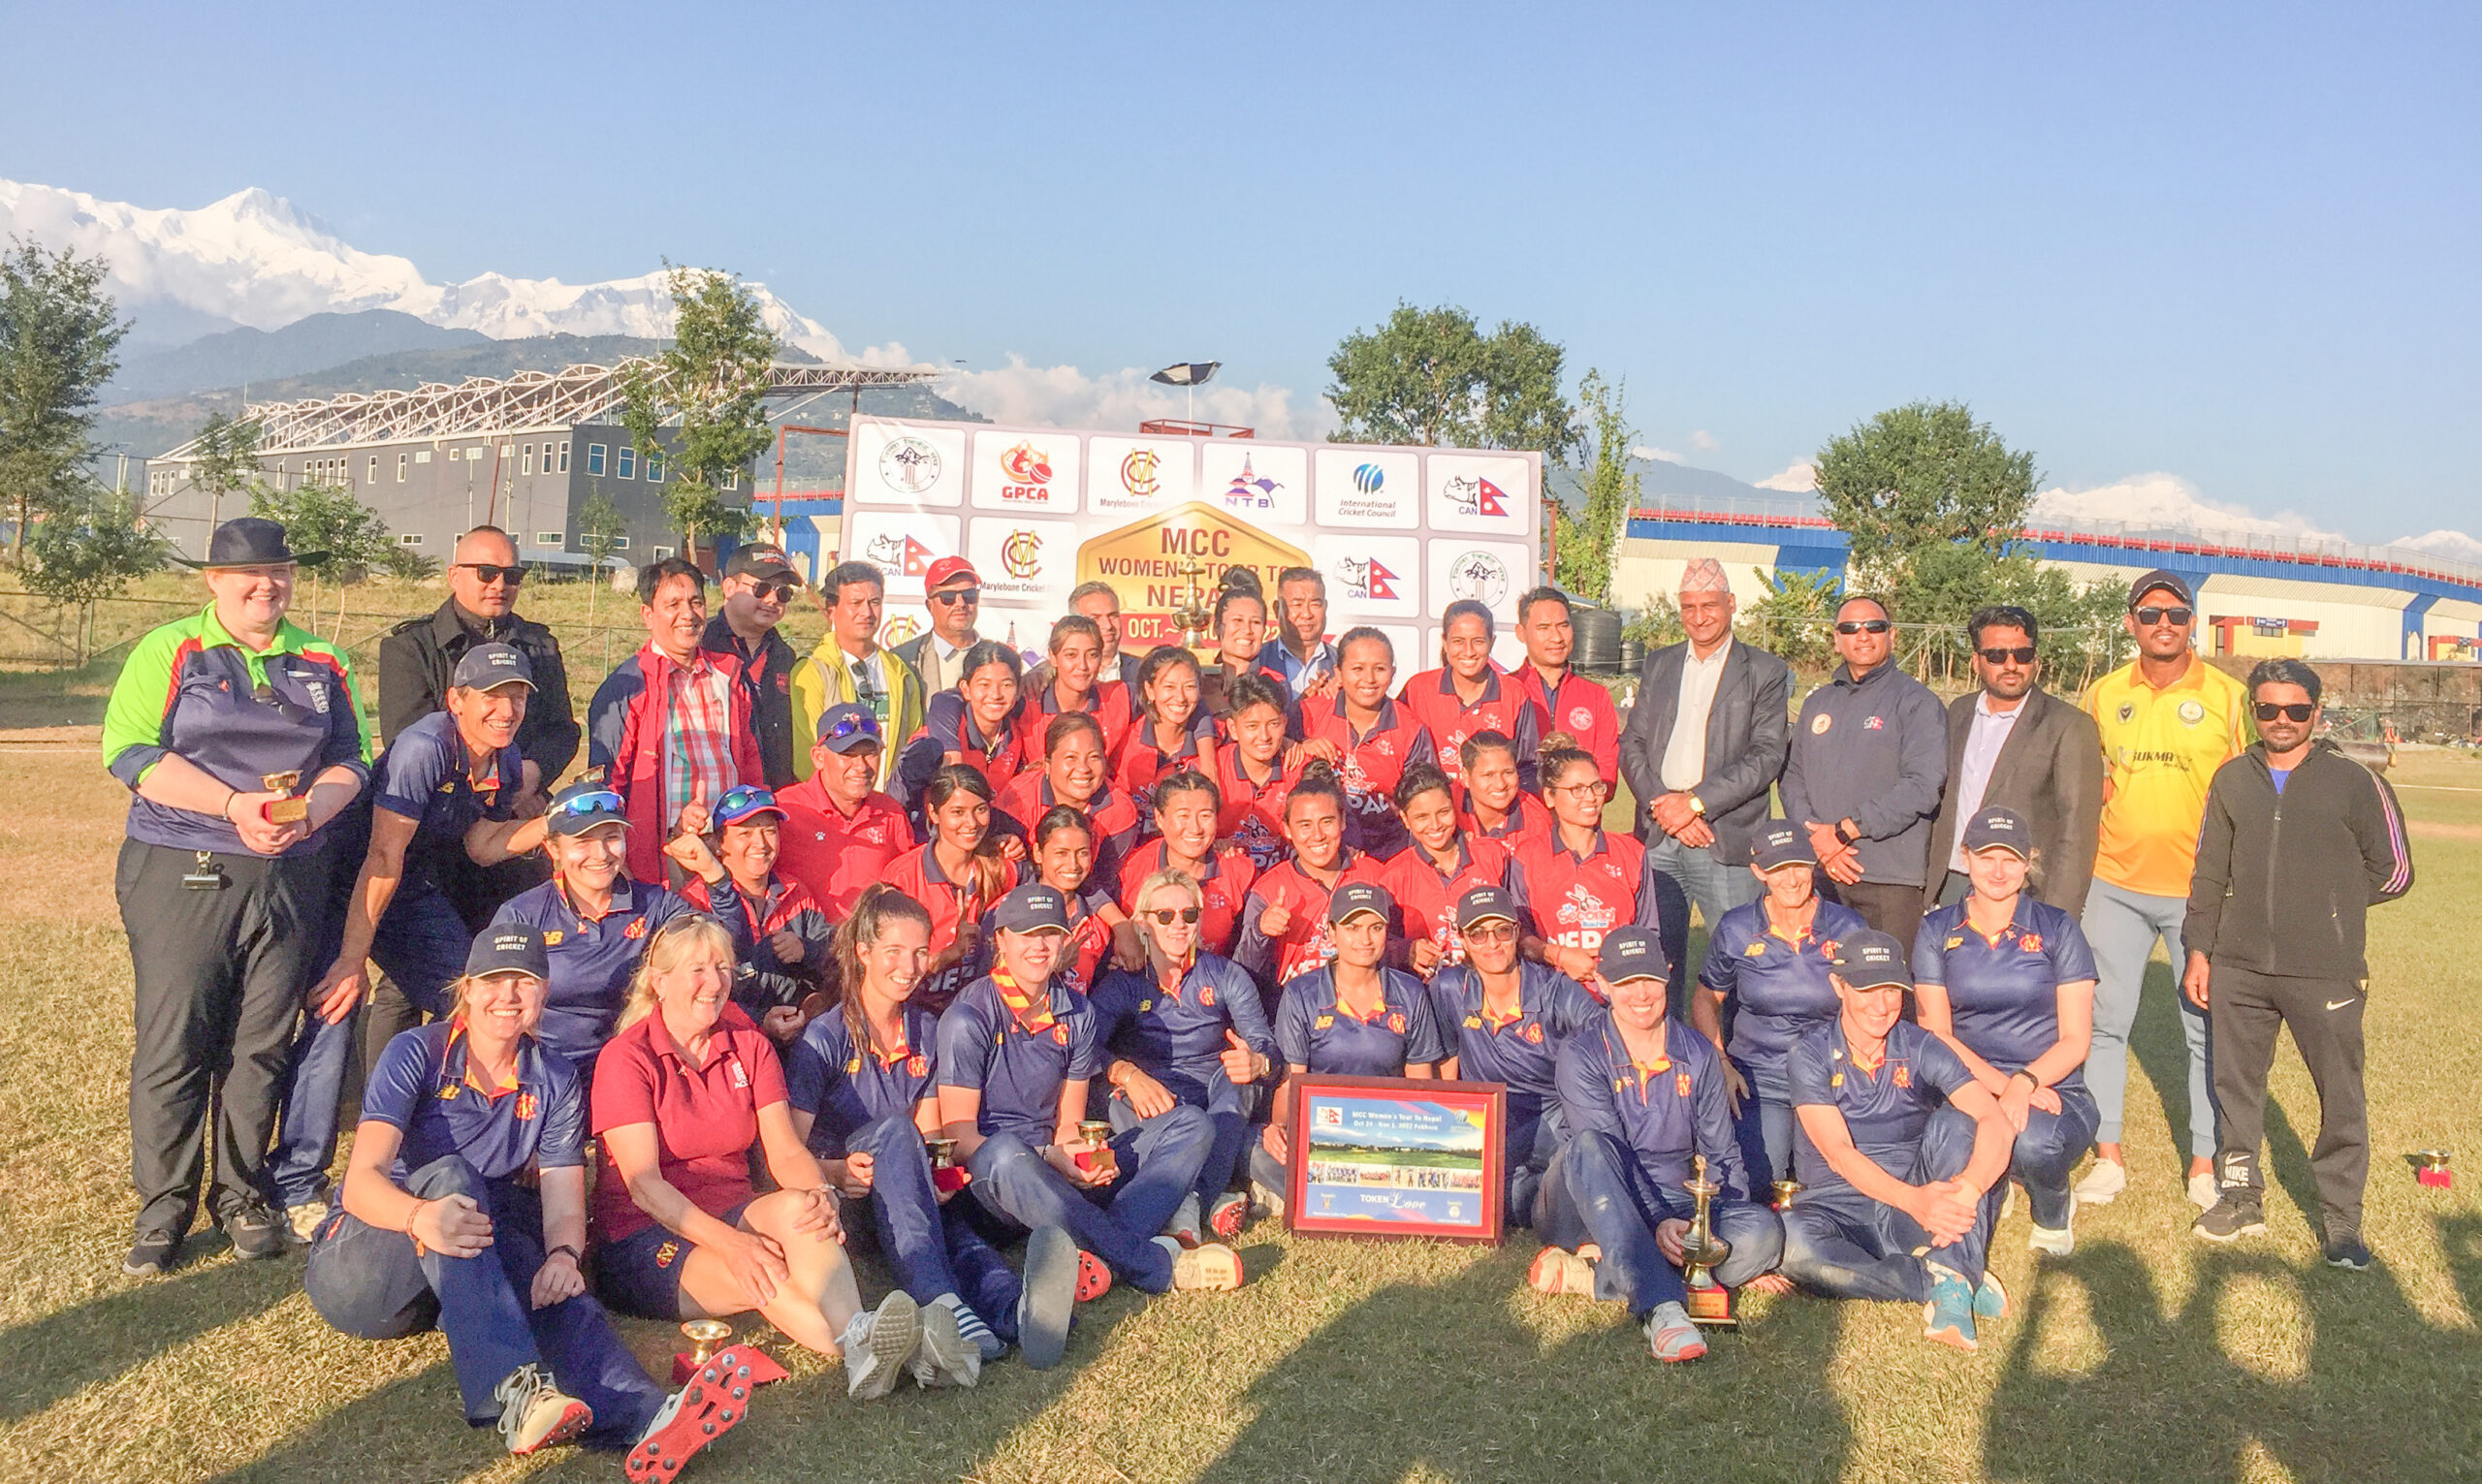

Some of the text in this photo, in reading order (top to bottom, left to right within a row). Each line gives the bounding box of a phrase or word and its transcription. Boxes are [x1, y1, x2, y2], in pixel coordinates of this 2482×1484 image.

[1002, 486, 1049, 501] GPCA
[1225, 496, 1269, 508] NTB
[1340, 499, 1396, 509] International
[1338, 508, 1396, 518] Cricket Council
[1459, 505, 1478, 516] CAN
[1161, 526, 1230, 557] MCC
[882, 568, 902, 577] CAN
[980, 582, 1020, 592] Marylebone
[1348, 589, 1367, 599] CAN
[1129, 617, 1163, 640] OCT.
[2132, 750, 2175, 762] SUKMA
[494, 934, 519, 944] SPIRIT
[495, 942, 525, 951] CRICKET
[2224, 1165, 2249, 1182] NIKE
[1360, 1193, 1389, 1204] TOKEN
